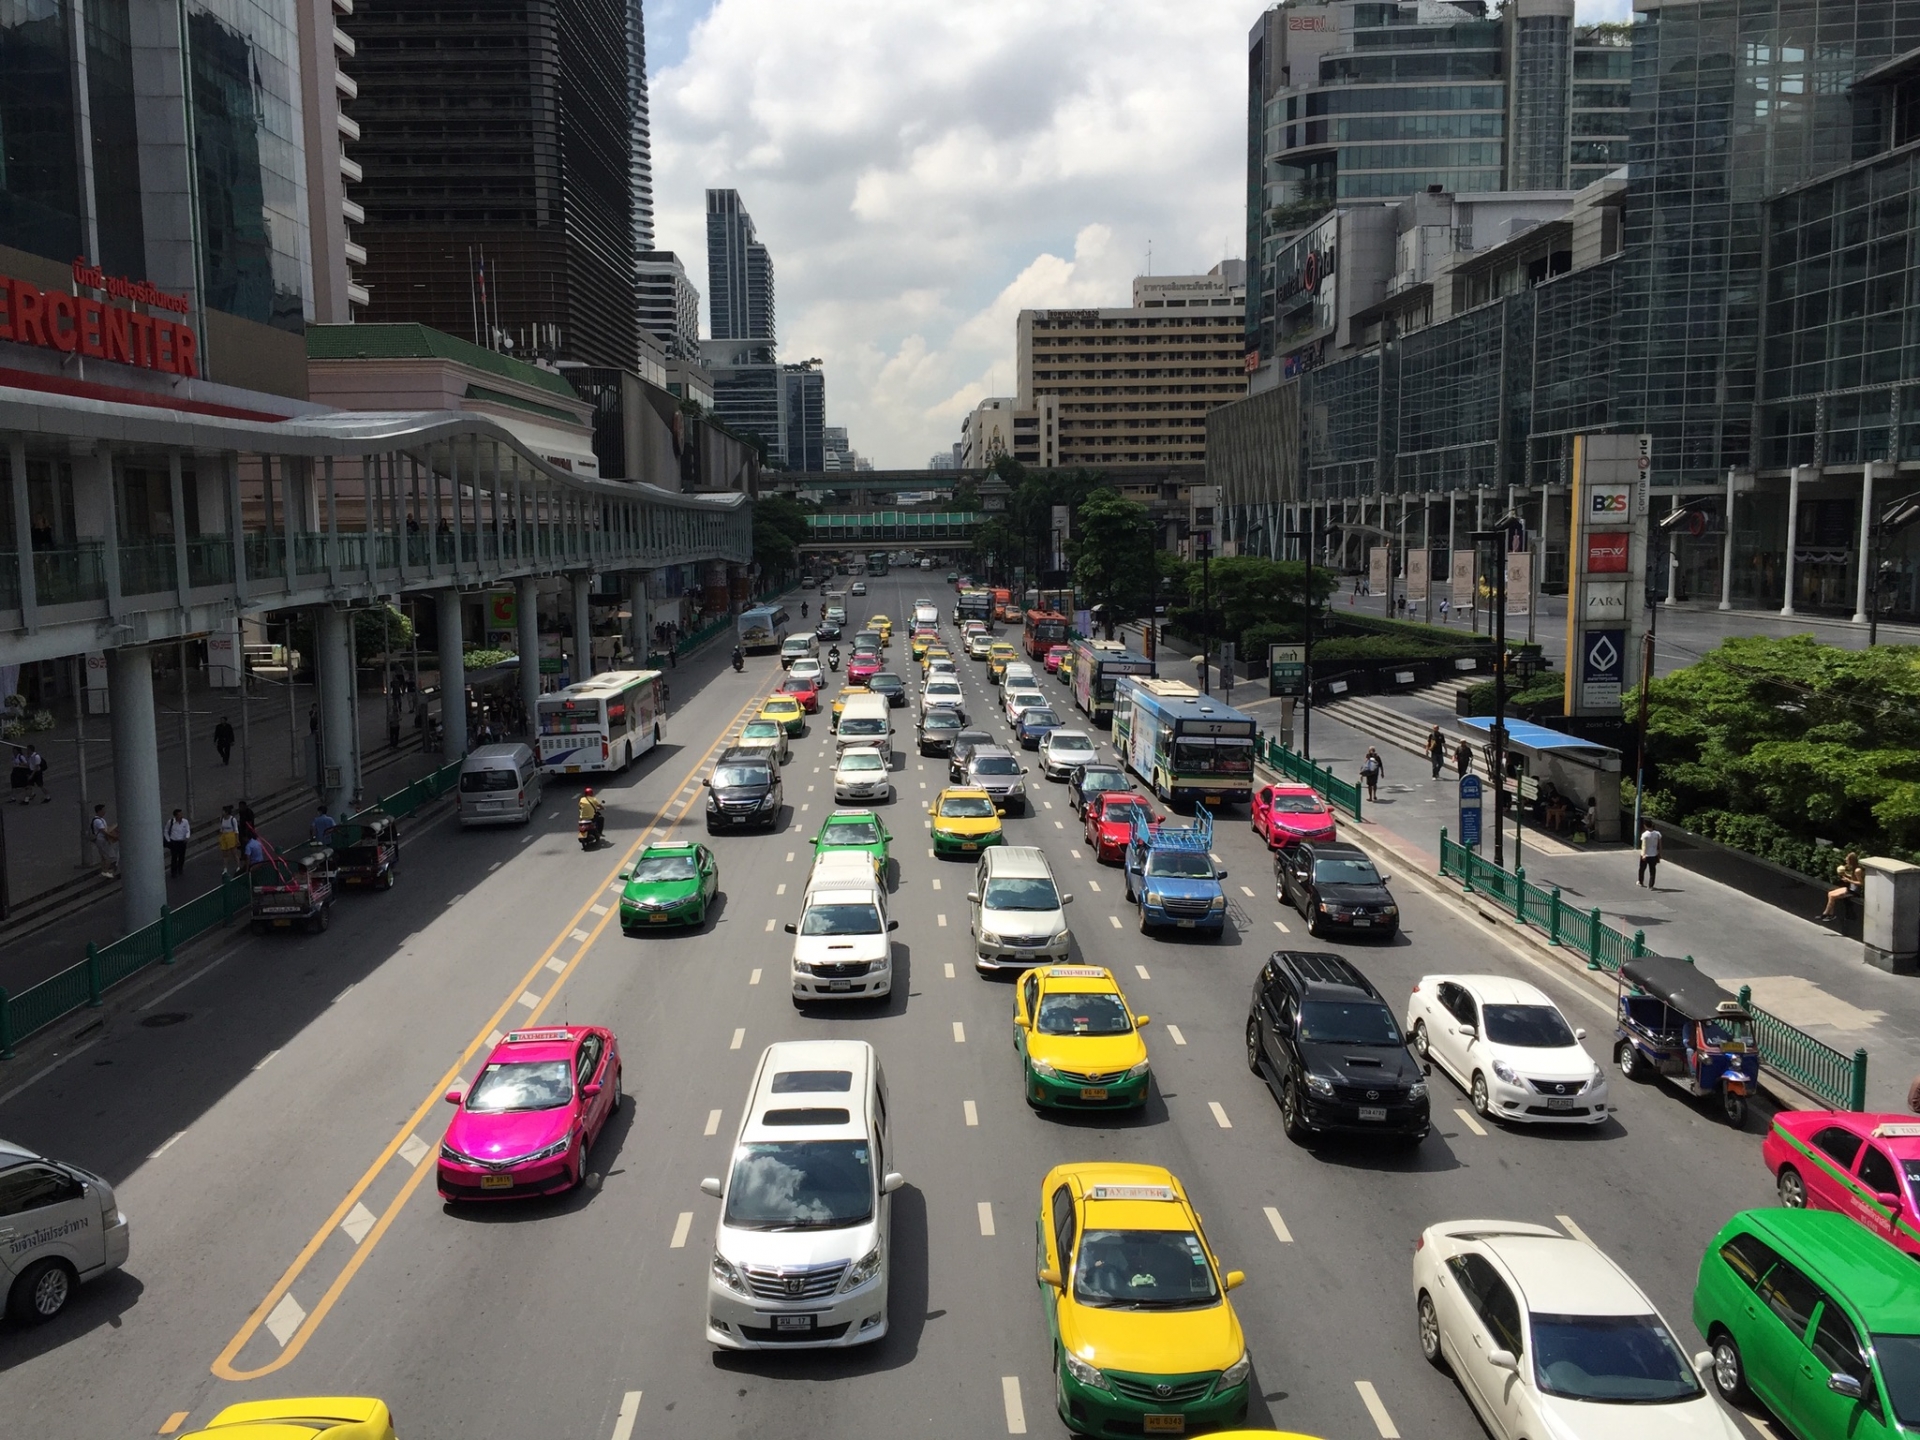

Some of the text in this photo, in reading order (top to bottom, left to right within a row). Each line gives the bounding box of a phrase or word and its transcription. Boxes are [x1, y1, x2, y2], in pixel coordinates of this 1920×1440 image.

[1289, 16, 1325, 31] ZEN
[1592, 494, 1627, 512] B2S
[1590, 547, 1624, 556] SFW
[1589, 596, 1623, 607] ZARA
[1209, 724, 1223, 733] 77
[517, 1032, 559, 1041] TAXI-METER
[9, 1218, 88, 1254] รับจ้างไม่ประจำทาง
